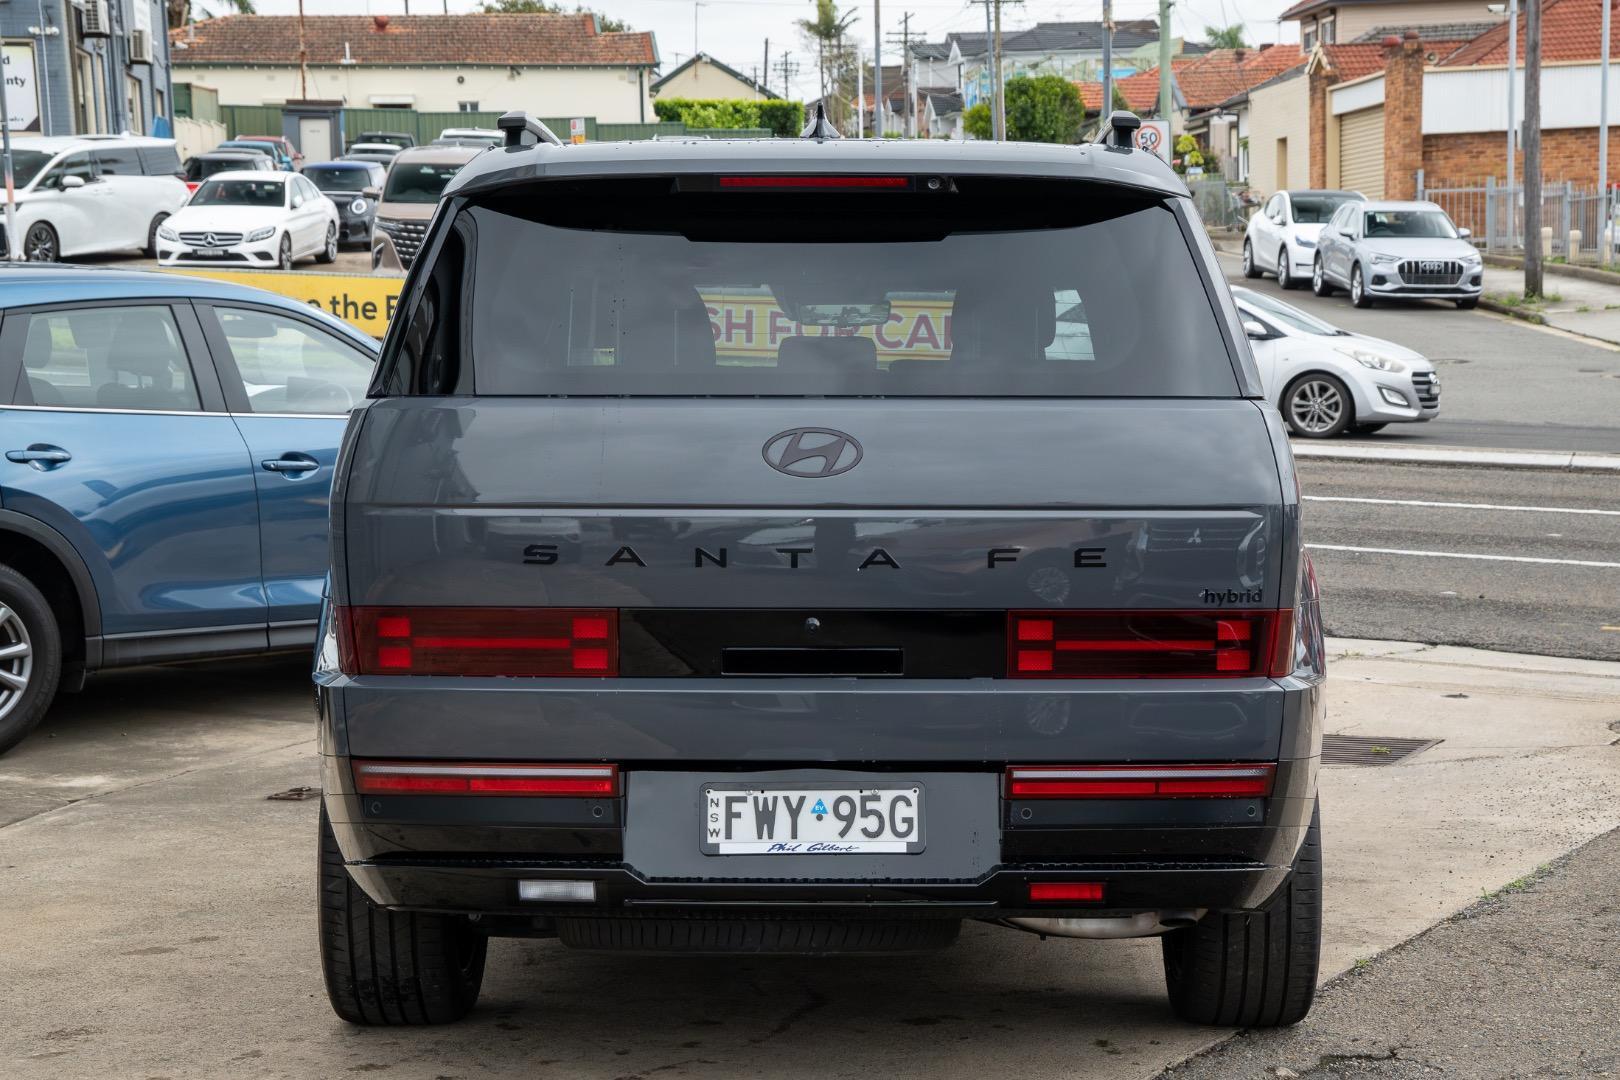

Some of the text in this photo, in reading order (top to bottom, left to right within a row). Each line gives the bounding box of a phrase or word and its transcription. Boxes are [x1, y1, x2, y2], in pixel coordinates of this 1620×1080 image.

[1140, 132, 1158, 146] 50
[329, 292, 378, 321] the
[522, 544, 1108, 569] SANTA FE
[1203, 588, 1263, 607] hybrid
[724, 794, 914, 840] FWY 95G
[767, 842, 859, 853] Phil Gilbert
